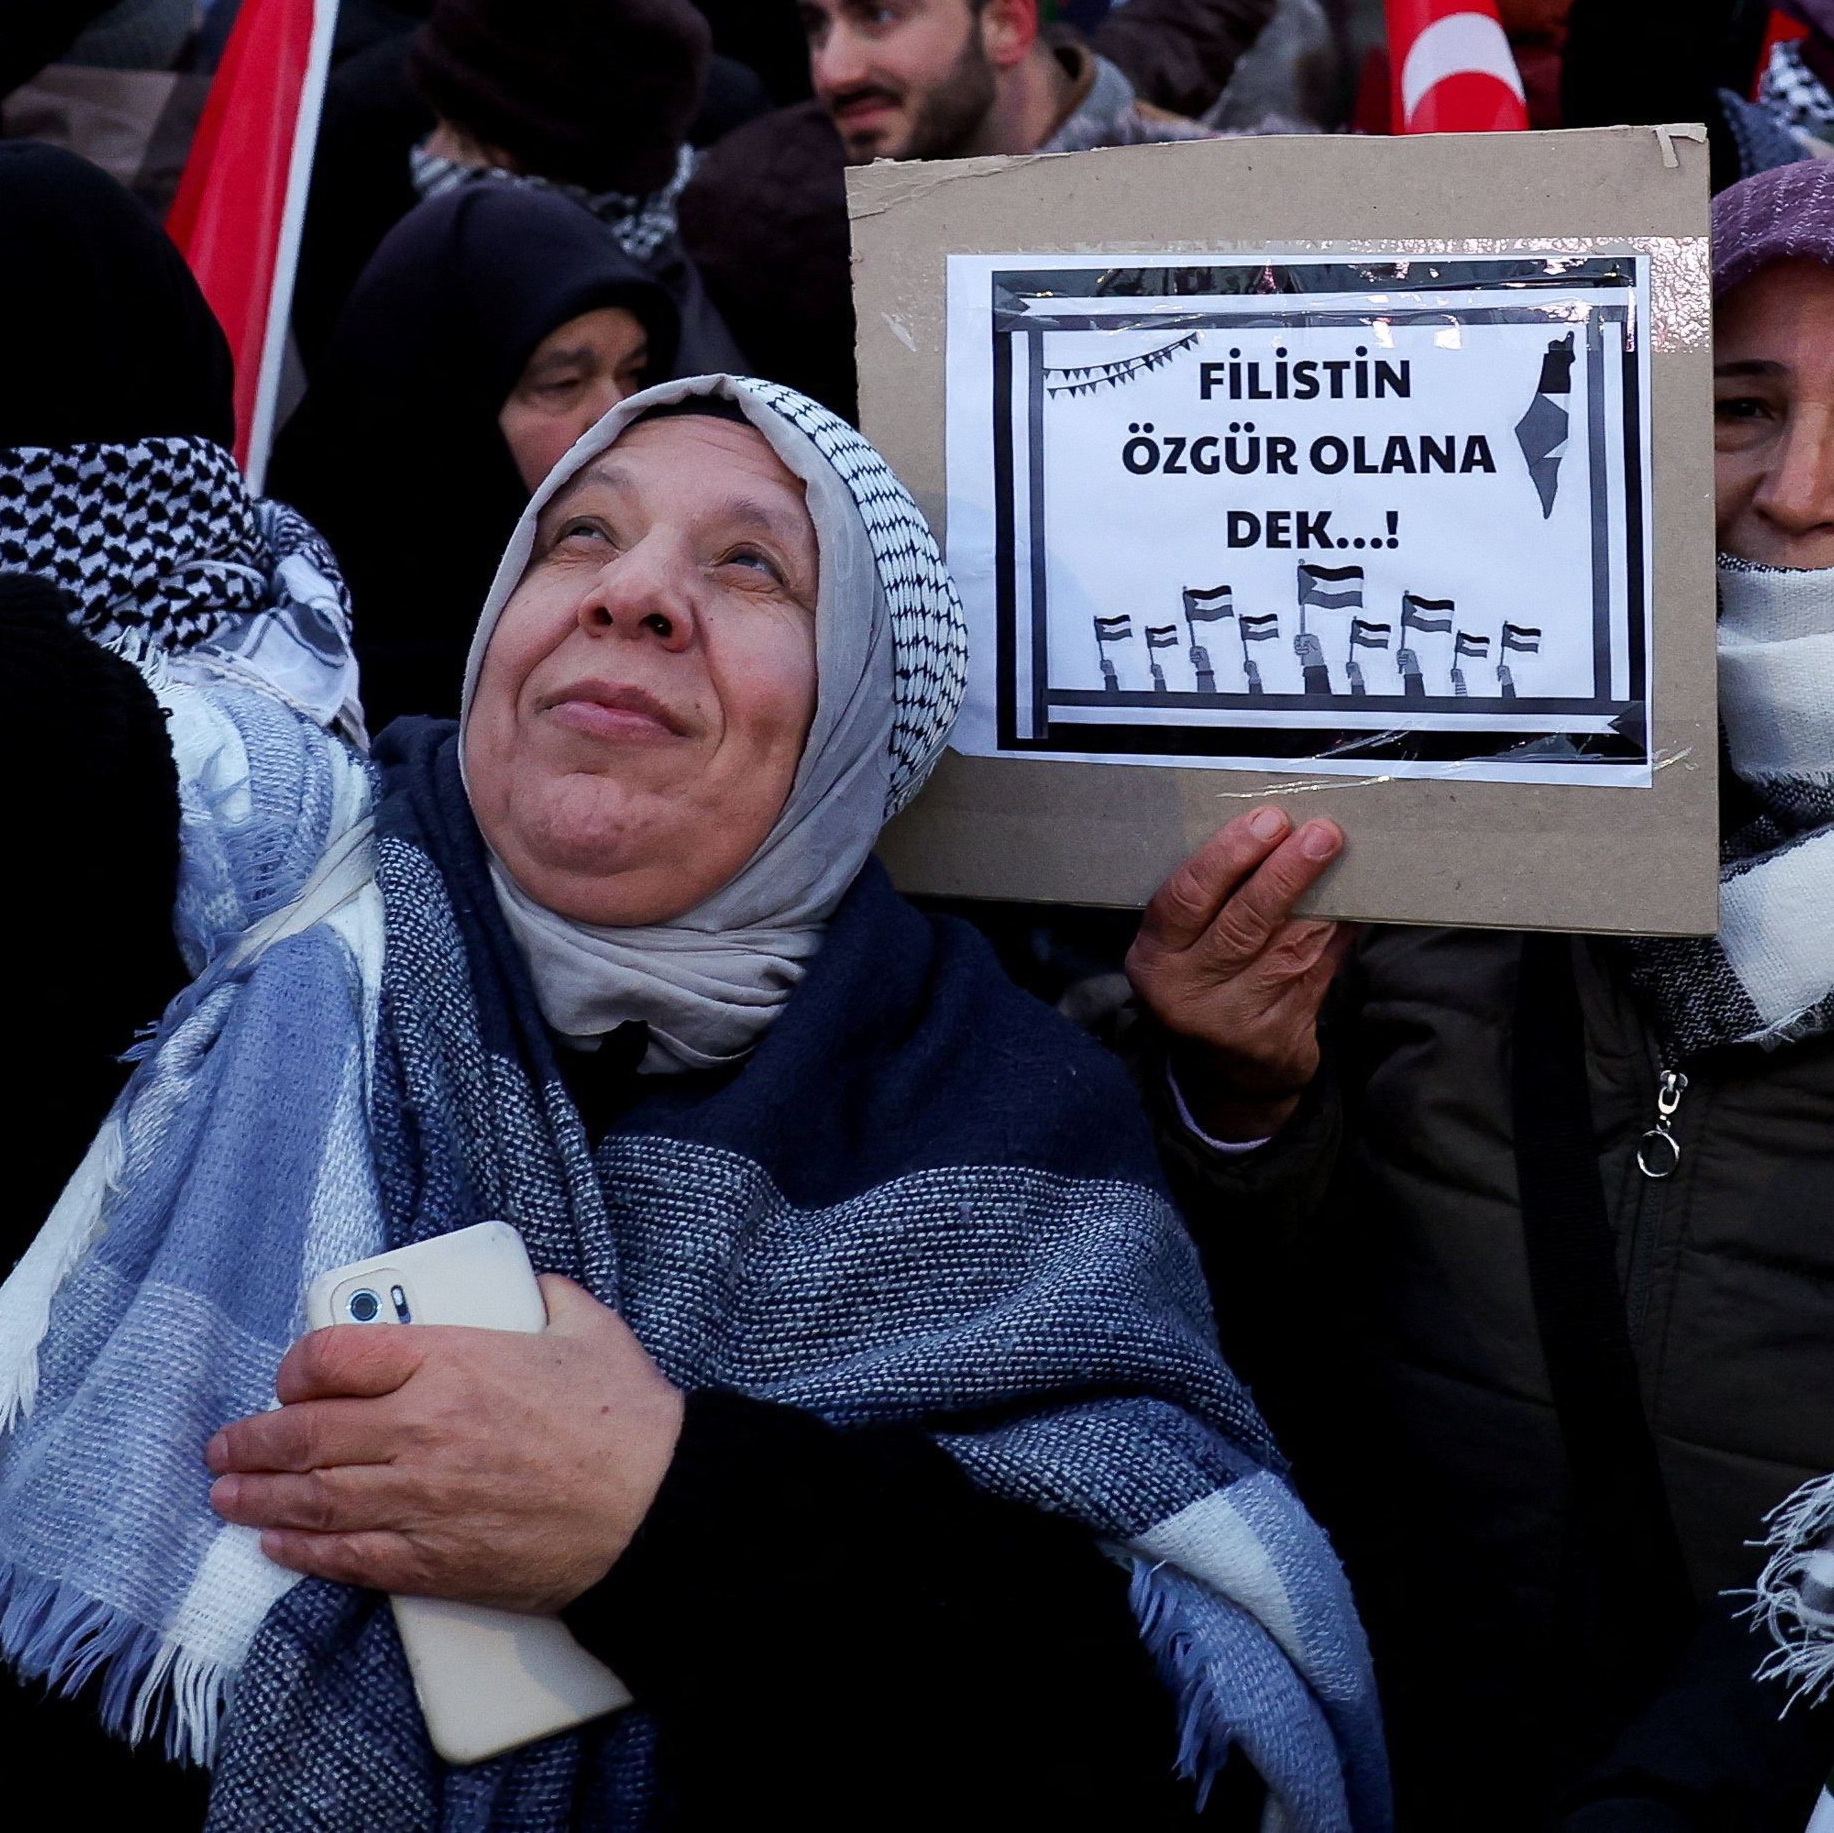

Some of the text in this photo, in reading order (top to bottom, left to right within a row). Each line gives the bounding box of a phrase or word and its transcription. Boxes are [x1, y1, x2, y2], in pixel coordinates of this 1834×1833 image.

[1200, 345, 1411, 400] FİLİSTİN
[1122, 422, 1497, 475] ÖZGÜR OLANA
[1227, 510, 1399, 550] DEK...!
